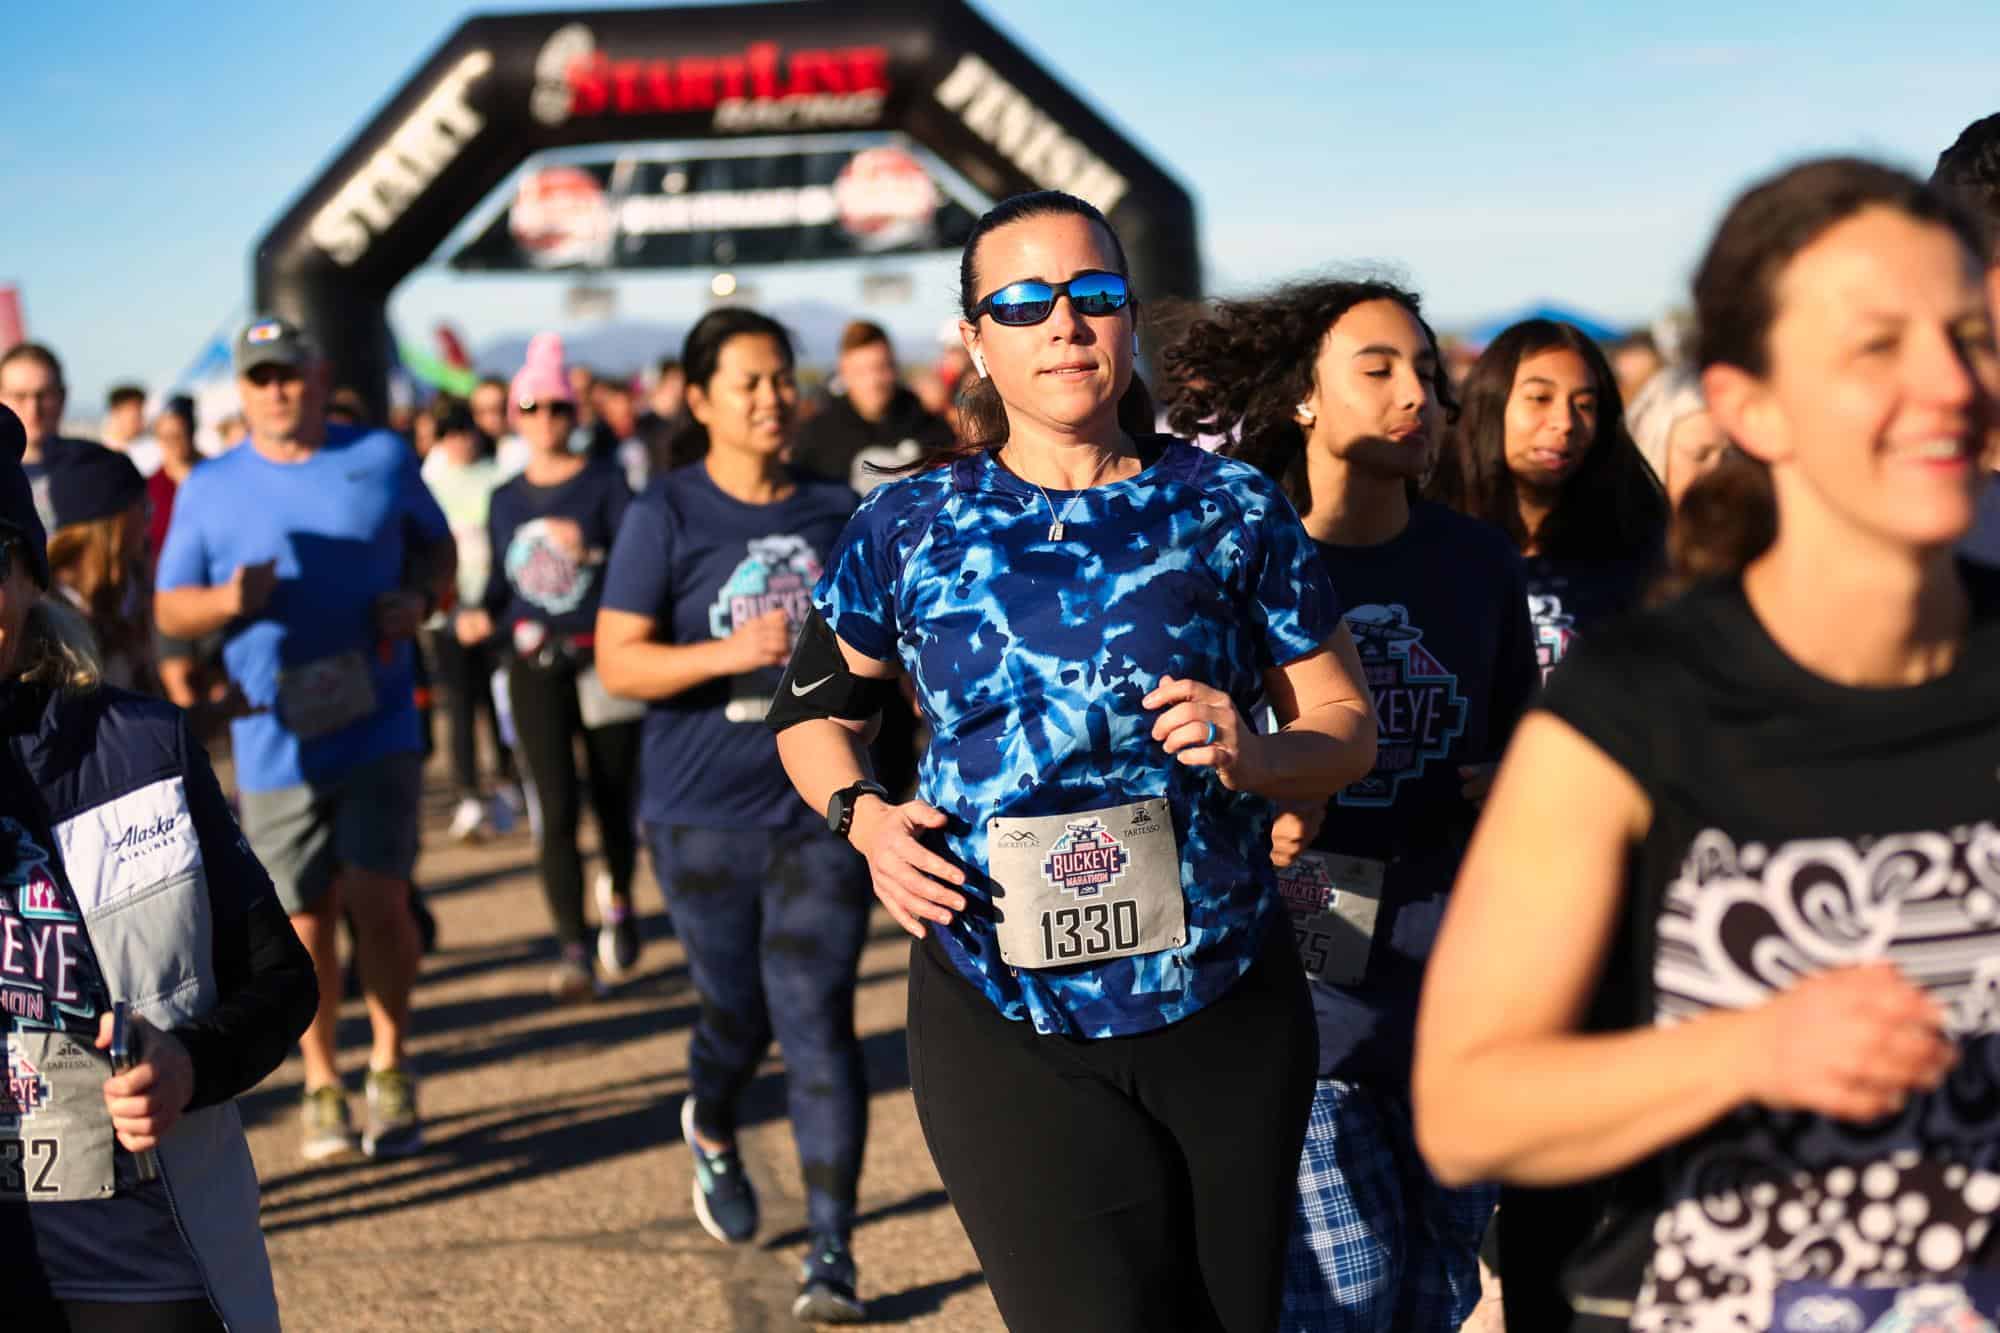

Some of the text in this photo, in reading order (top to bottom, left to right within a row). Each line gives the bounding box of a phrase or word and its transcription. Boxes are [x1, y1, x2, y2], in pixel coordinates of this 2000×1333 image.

[310, 50, 492, 266] START
[112, 815, 175, 852] Alaska
[1053, 846, 1119, 880] BUCKEYE
[1066, 872, 1108, 887] MARATHON
[1041, 901, 1139, 961] 1330
[0, 915, 78, 1000] EYE
